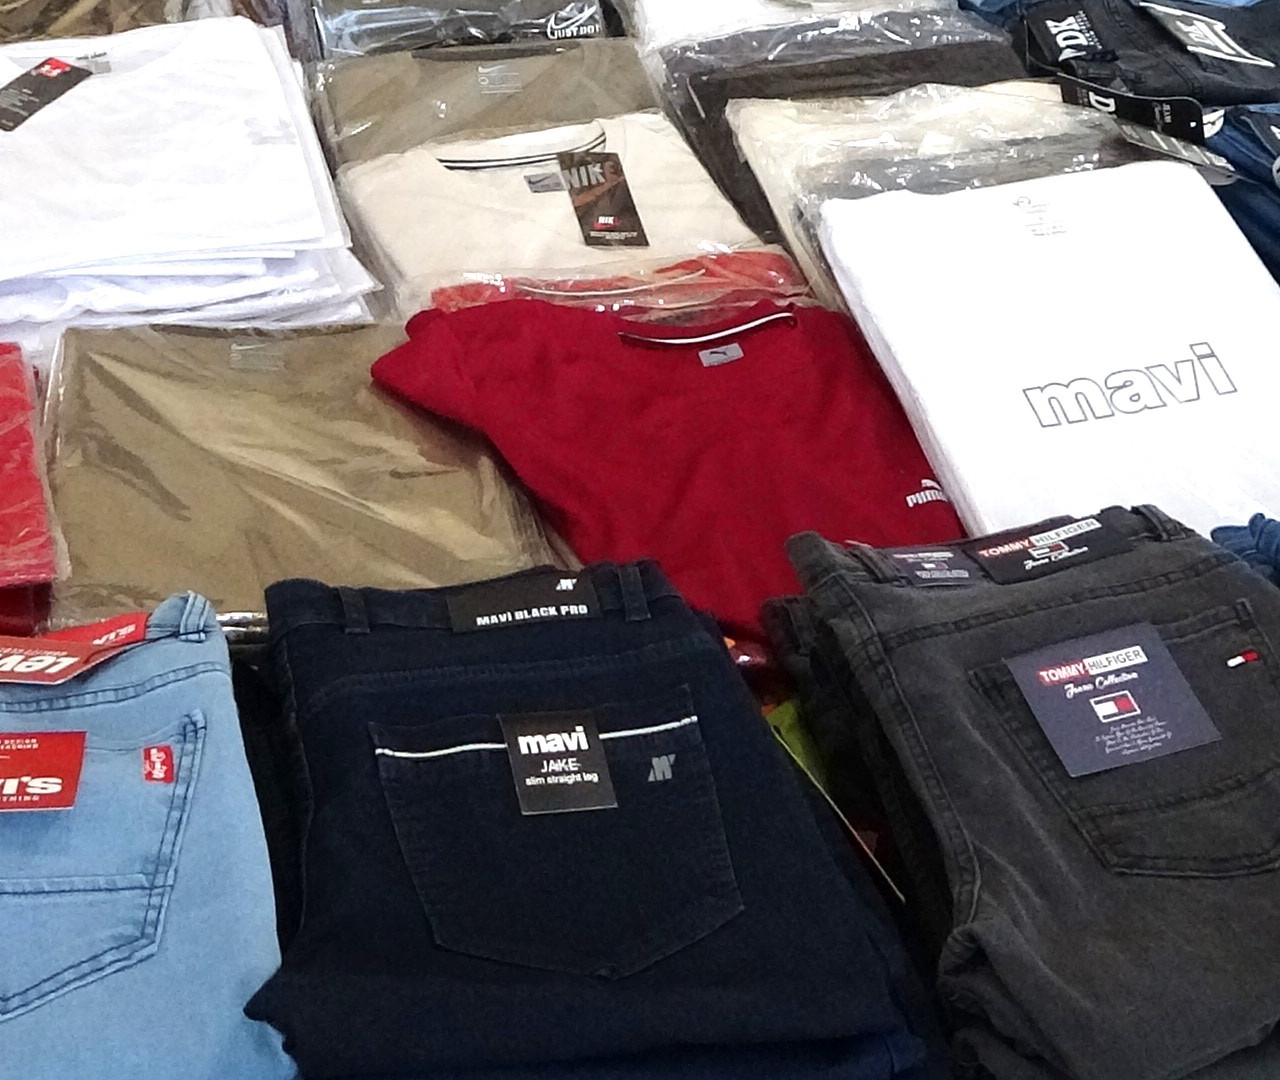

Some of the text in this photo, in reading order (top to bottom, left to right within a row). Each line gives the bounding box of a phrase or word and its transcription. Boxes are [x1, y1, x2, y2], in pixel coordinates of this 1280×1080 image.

[1023, 342, 1237, 428] mavi
[978, 520, 1098, 558] TOMMY HILFIGER
[514, 606, 558, 620] BLACK
[560, 604, 588, 616] PRO
[1039, 649, 1144, 683] TOMMY HILFIGER
[518, 726, 589, 755] mavi
[525, 772, 599, 786] slim straight leg
[541, 758, 579, 773] JAKE
